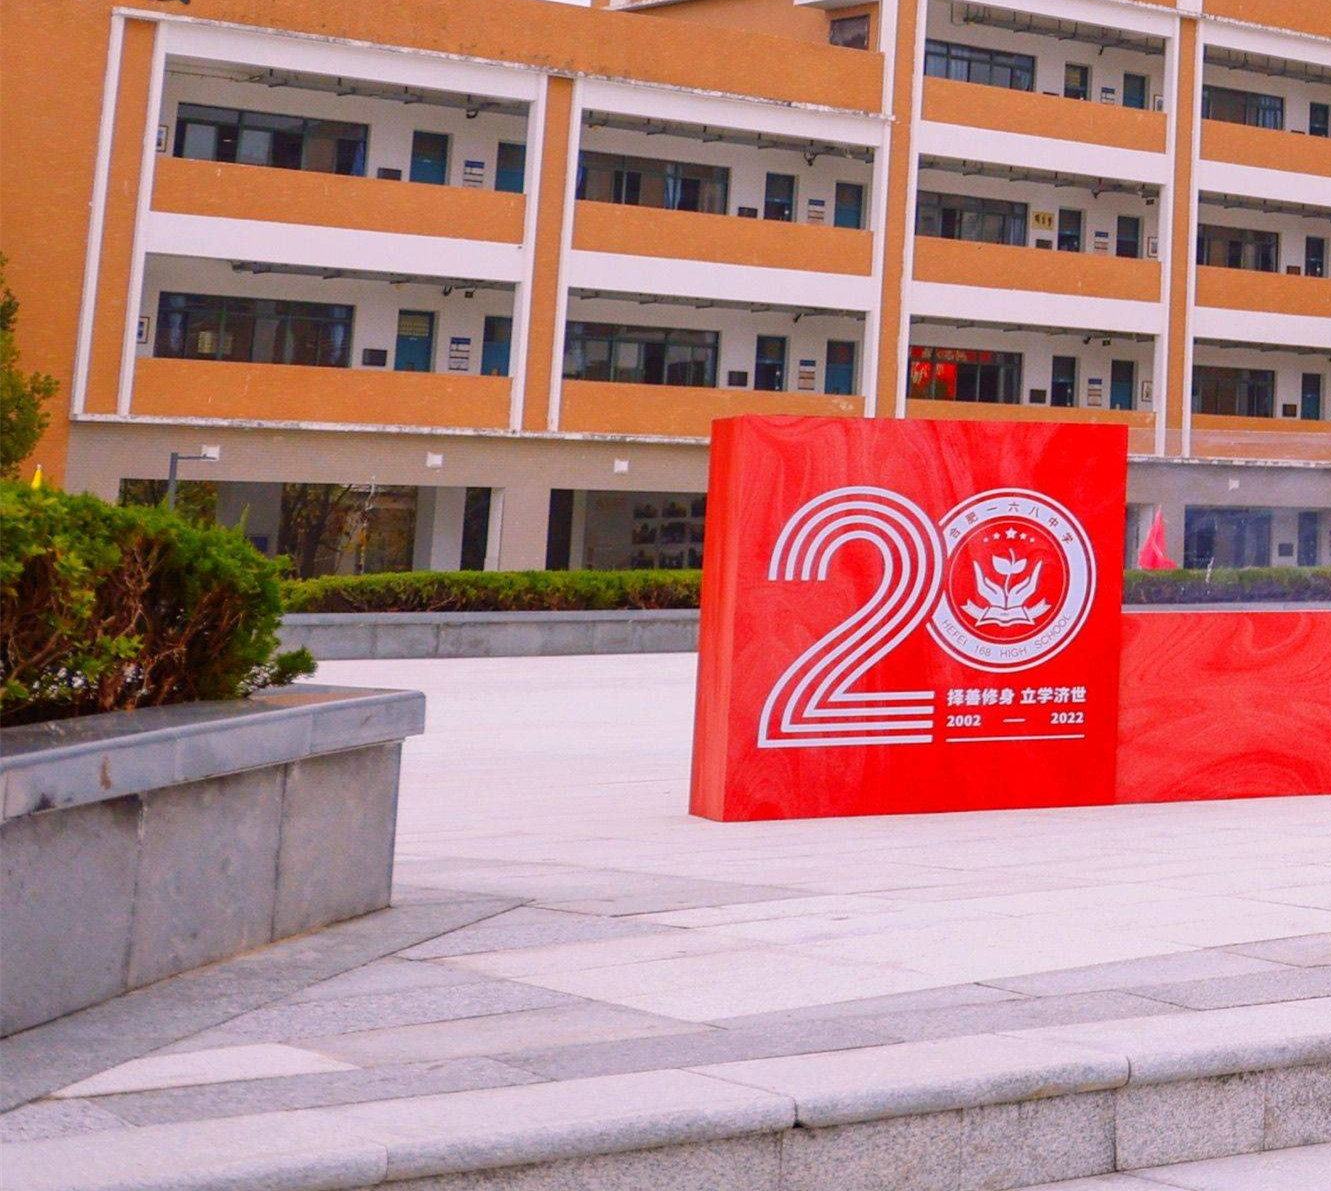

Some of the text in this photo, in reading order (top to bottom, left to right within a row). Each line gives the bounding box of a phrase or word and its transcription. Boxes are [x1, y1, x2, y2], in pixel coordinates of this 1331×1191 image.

[949, 501, 1075, 546] 合肥一六八中学
[942, 614, 1072, 659] HEFEI 168 HIGH SCHOOL
[947, 686, 1087, 706] 择善修身 立学济世
[946, 714, 982, 727] 2002
[1050, 712, 1084, 724] 2022
